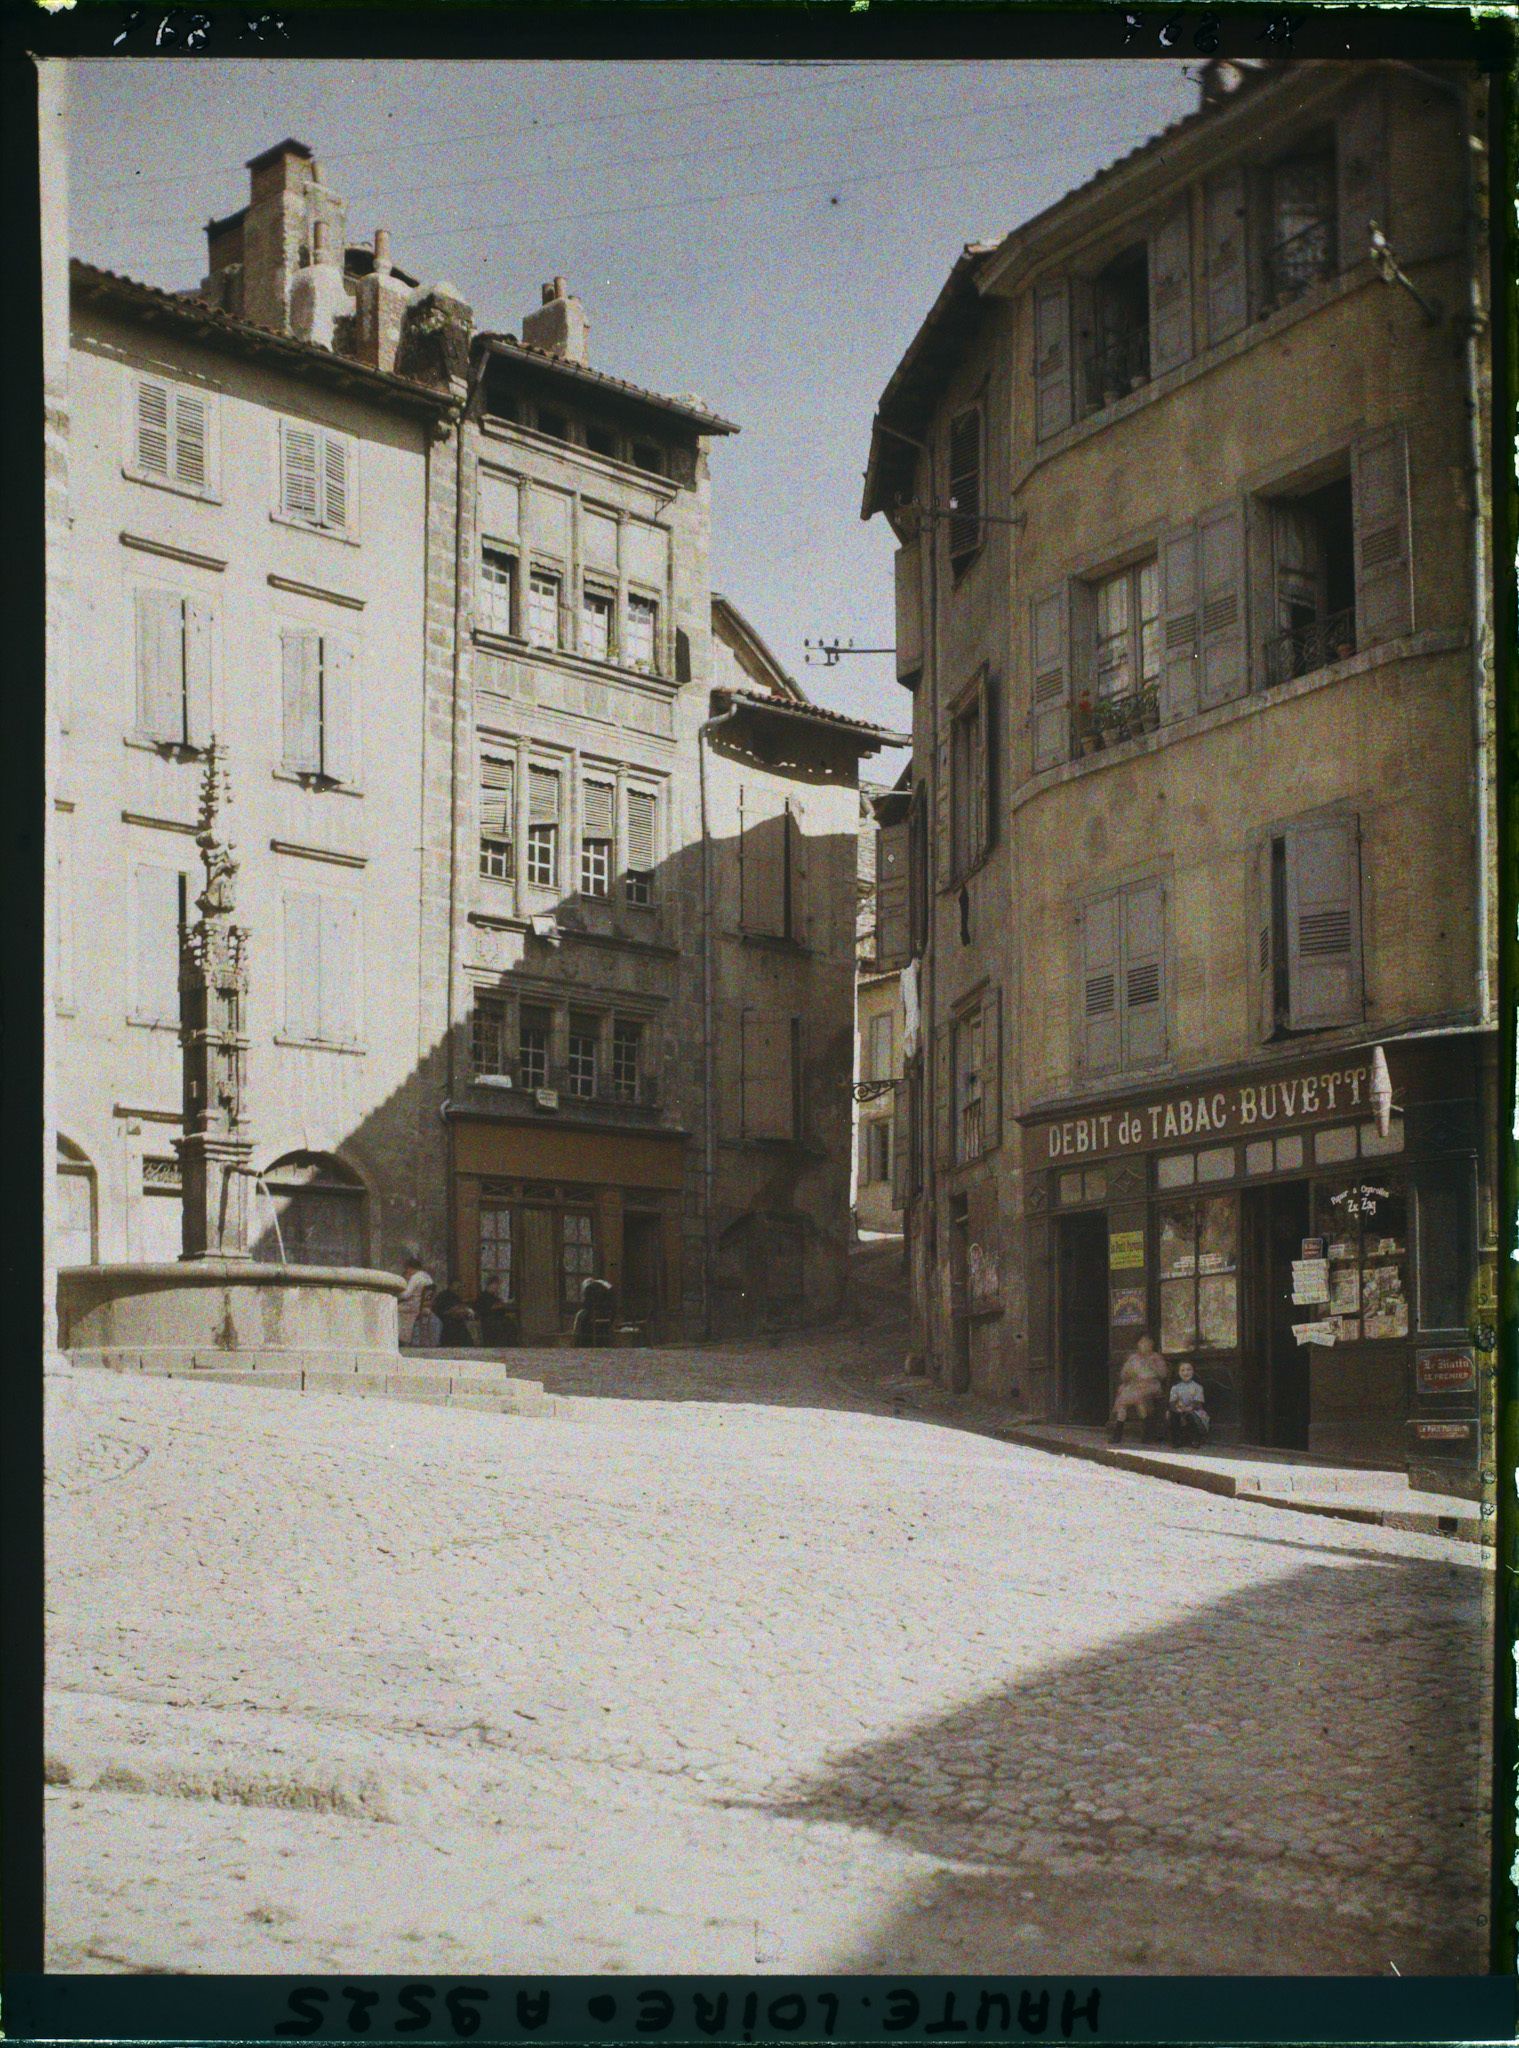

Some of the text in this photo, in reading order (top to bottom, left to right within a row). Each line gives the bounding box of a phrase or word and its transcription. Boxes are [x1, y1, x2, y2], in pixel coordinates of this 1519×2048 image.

[1049, 1064, 1375, 1158] DEBIT de TABAC BUVETT
